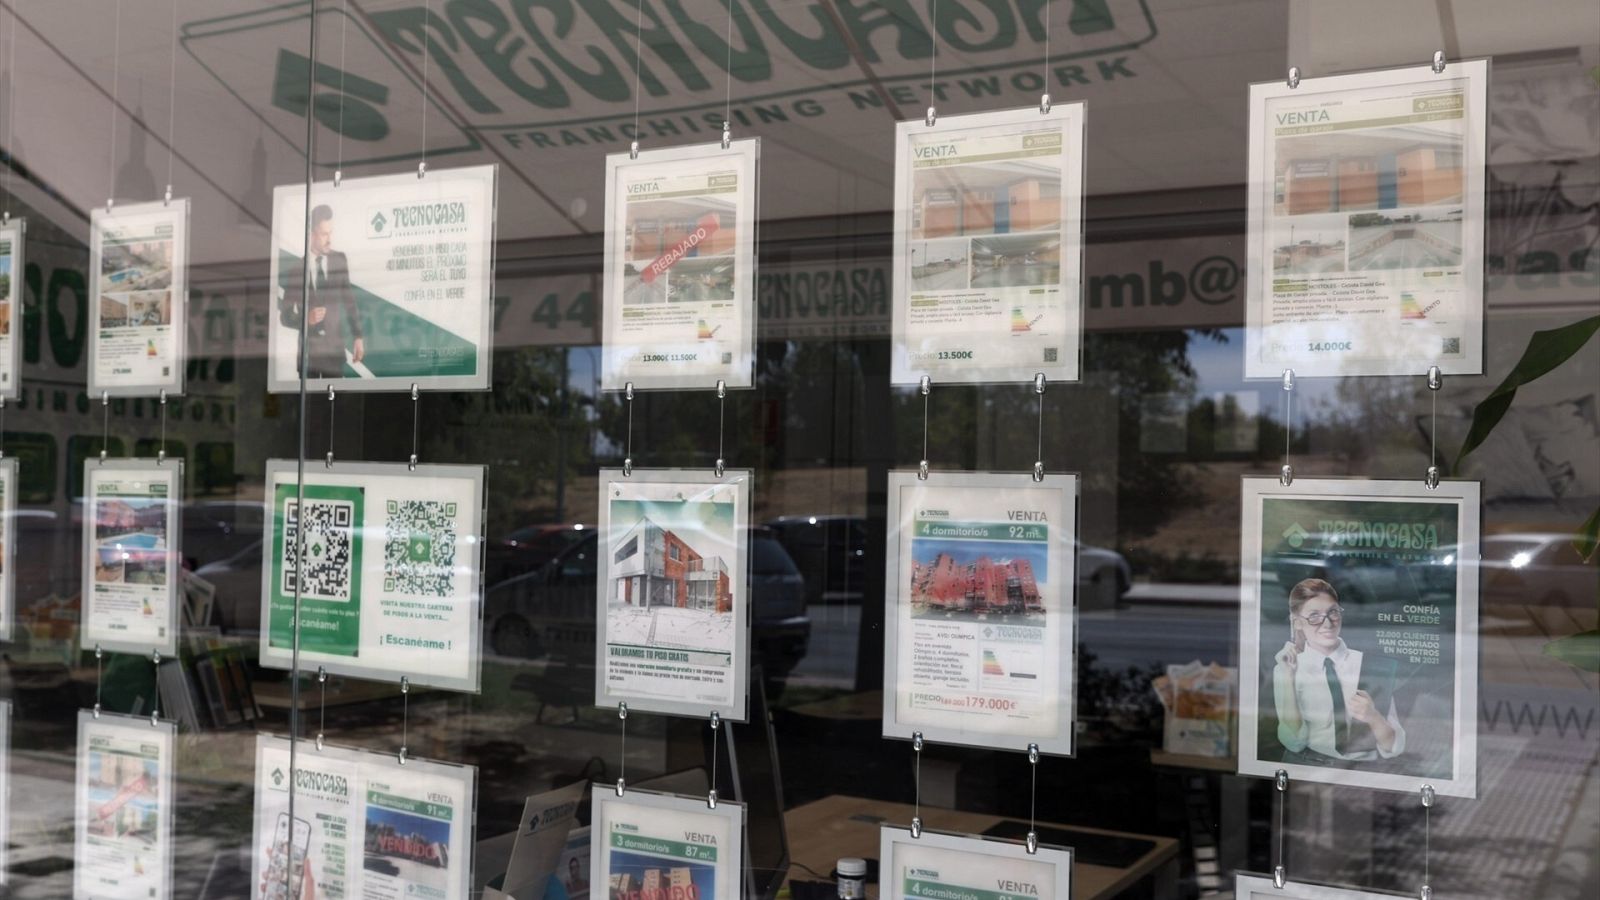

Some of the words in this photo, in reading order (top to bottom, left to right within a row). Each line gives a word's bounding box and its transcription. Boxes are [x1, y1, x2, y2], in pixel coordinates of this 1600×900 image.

[503, 97, 825, 149] FRANCHISING
[840, 56, 1139, 110] NETWORK
[1276, 109, 1330, 125] VENTA
[913, 144, 957, 158] VENTA
[627, 182, 659, 193] VENTA
[392, 202, 465, 228] TECNOCASA
[651, 227, 706, 275] REBAJADO
[1308, 341, 1353, 352] 14.000€
[643, 354, 669, 363] 13.000€
[671, 353, 698, 362] 11.500€
[937, 350, 974, 360] 13.500€
[1007, 510, 1048, 522] VENTA
[923, 523, 930, 535] 4
[932, 527, 988, 537] dormitorio/s
[1009, 526, 1024, 538] 92
[1318, 520, 1438, 550] TECNOCASA
[380, 600, 398, 608] VISITA
[399, 601, 425, 610] NUESTRA
[427, 603, 453, 612] CARTERA
[1403, 603, 1440, 614] CONFÍA
[1378, 613, 1391, 622] EN
[1393, 614, 1405, 623] EL
[1407, 616, 1440, 625] VERDE
[386, 634, 446, 650] Escanéame
[1403, 631, 1439, 641] CLIENTES
[1379, 638, 1396, 647] HAN
[1398, 639, 1439, 649] CONFIADO
[610, 647, 645, 659] VALORAMOS
[646, 650, 654, 659] TU
[654, 651, 668, 661] PISO
[668, 652, 689, 662] GRATIS
[1396, 647, 1439, 657] NOSOTROS
[1410, 656, 1421, 664] EN
[915, 692, 941, 702] PRECIO
[427, 791, 454, 805] VENTA
[427, 804, 438, 816] 91
[684, 831, 717, 845] VENTA
[379, 835, 439, 859] VENDIDO
[617, 835, 623, 846] 3
[624, 838, 670, 854] dormitorio/s
[685, 845, 698, 857] 87
[912, 882, 920, 895] 4
[997, 879, 1038, 896] VENTA
